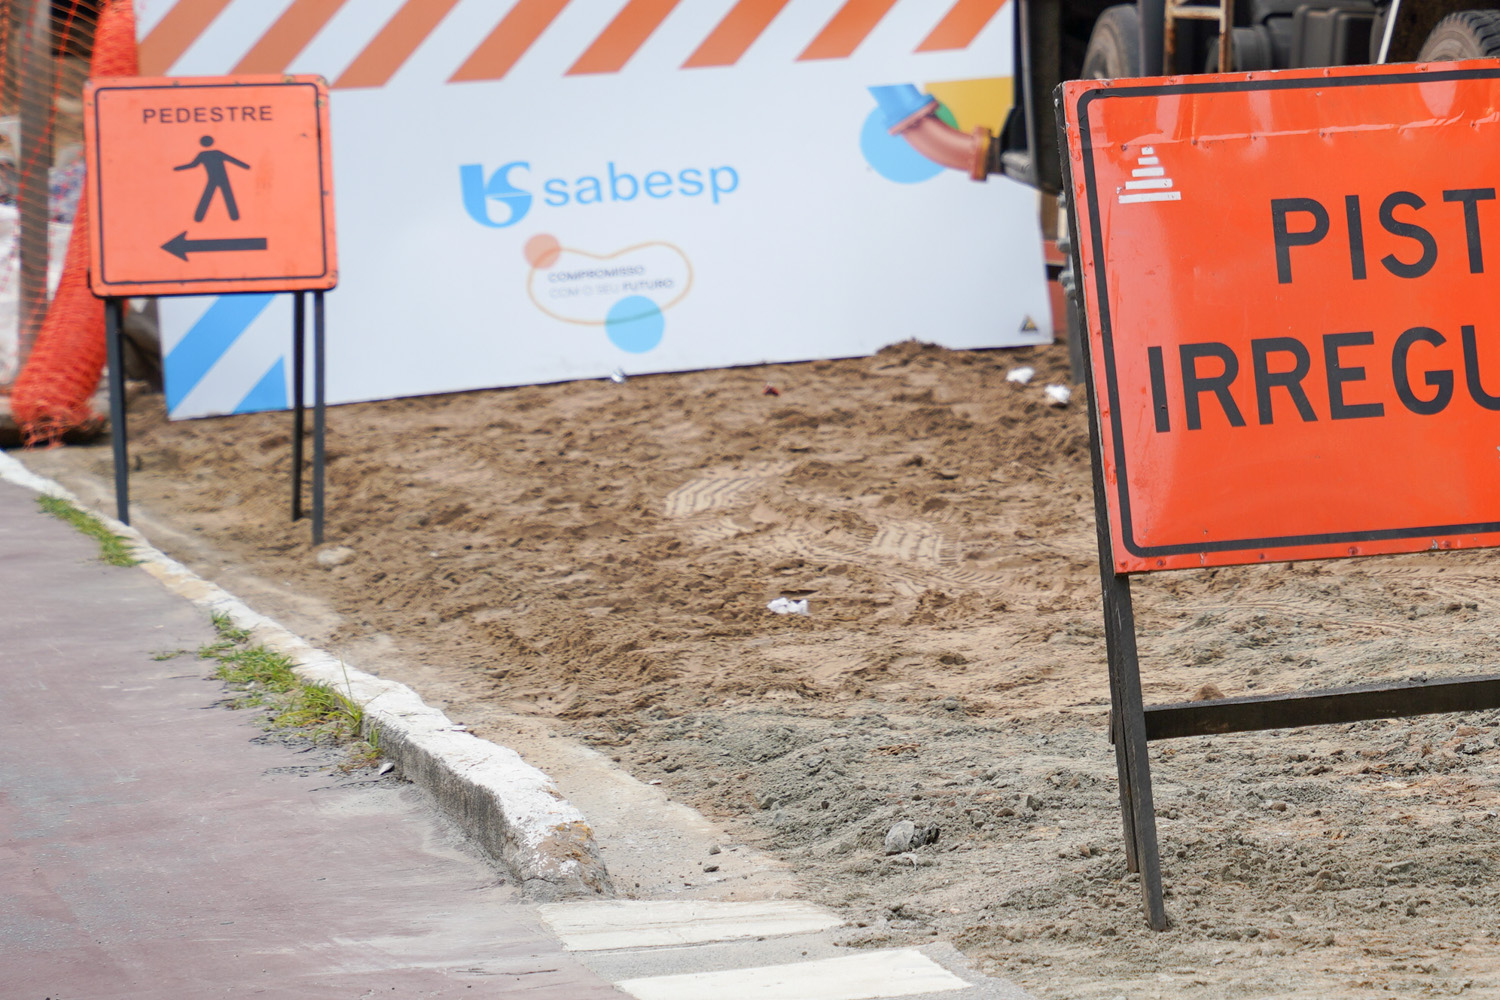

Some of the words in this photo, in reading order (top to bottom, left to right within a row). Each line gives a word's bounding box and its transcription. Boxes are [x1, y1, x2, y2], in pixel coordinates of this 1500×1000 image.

[142, 105, 273, 124] PEDESTRE
[543, 161, 740, 207] sabesp
[547, 266, 645, 282] COMPROMISSO
[622, 278, 675, 292] FUTURO
